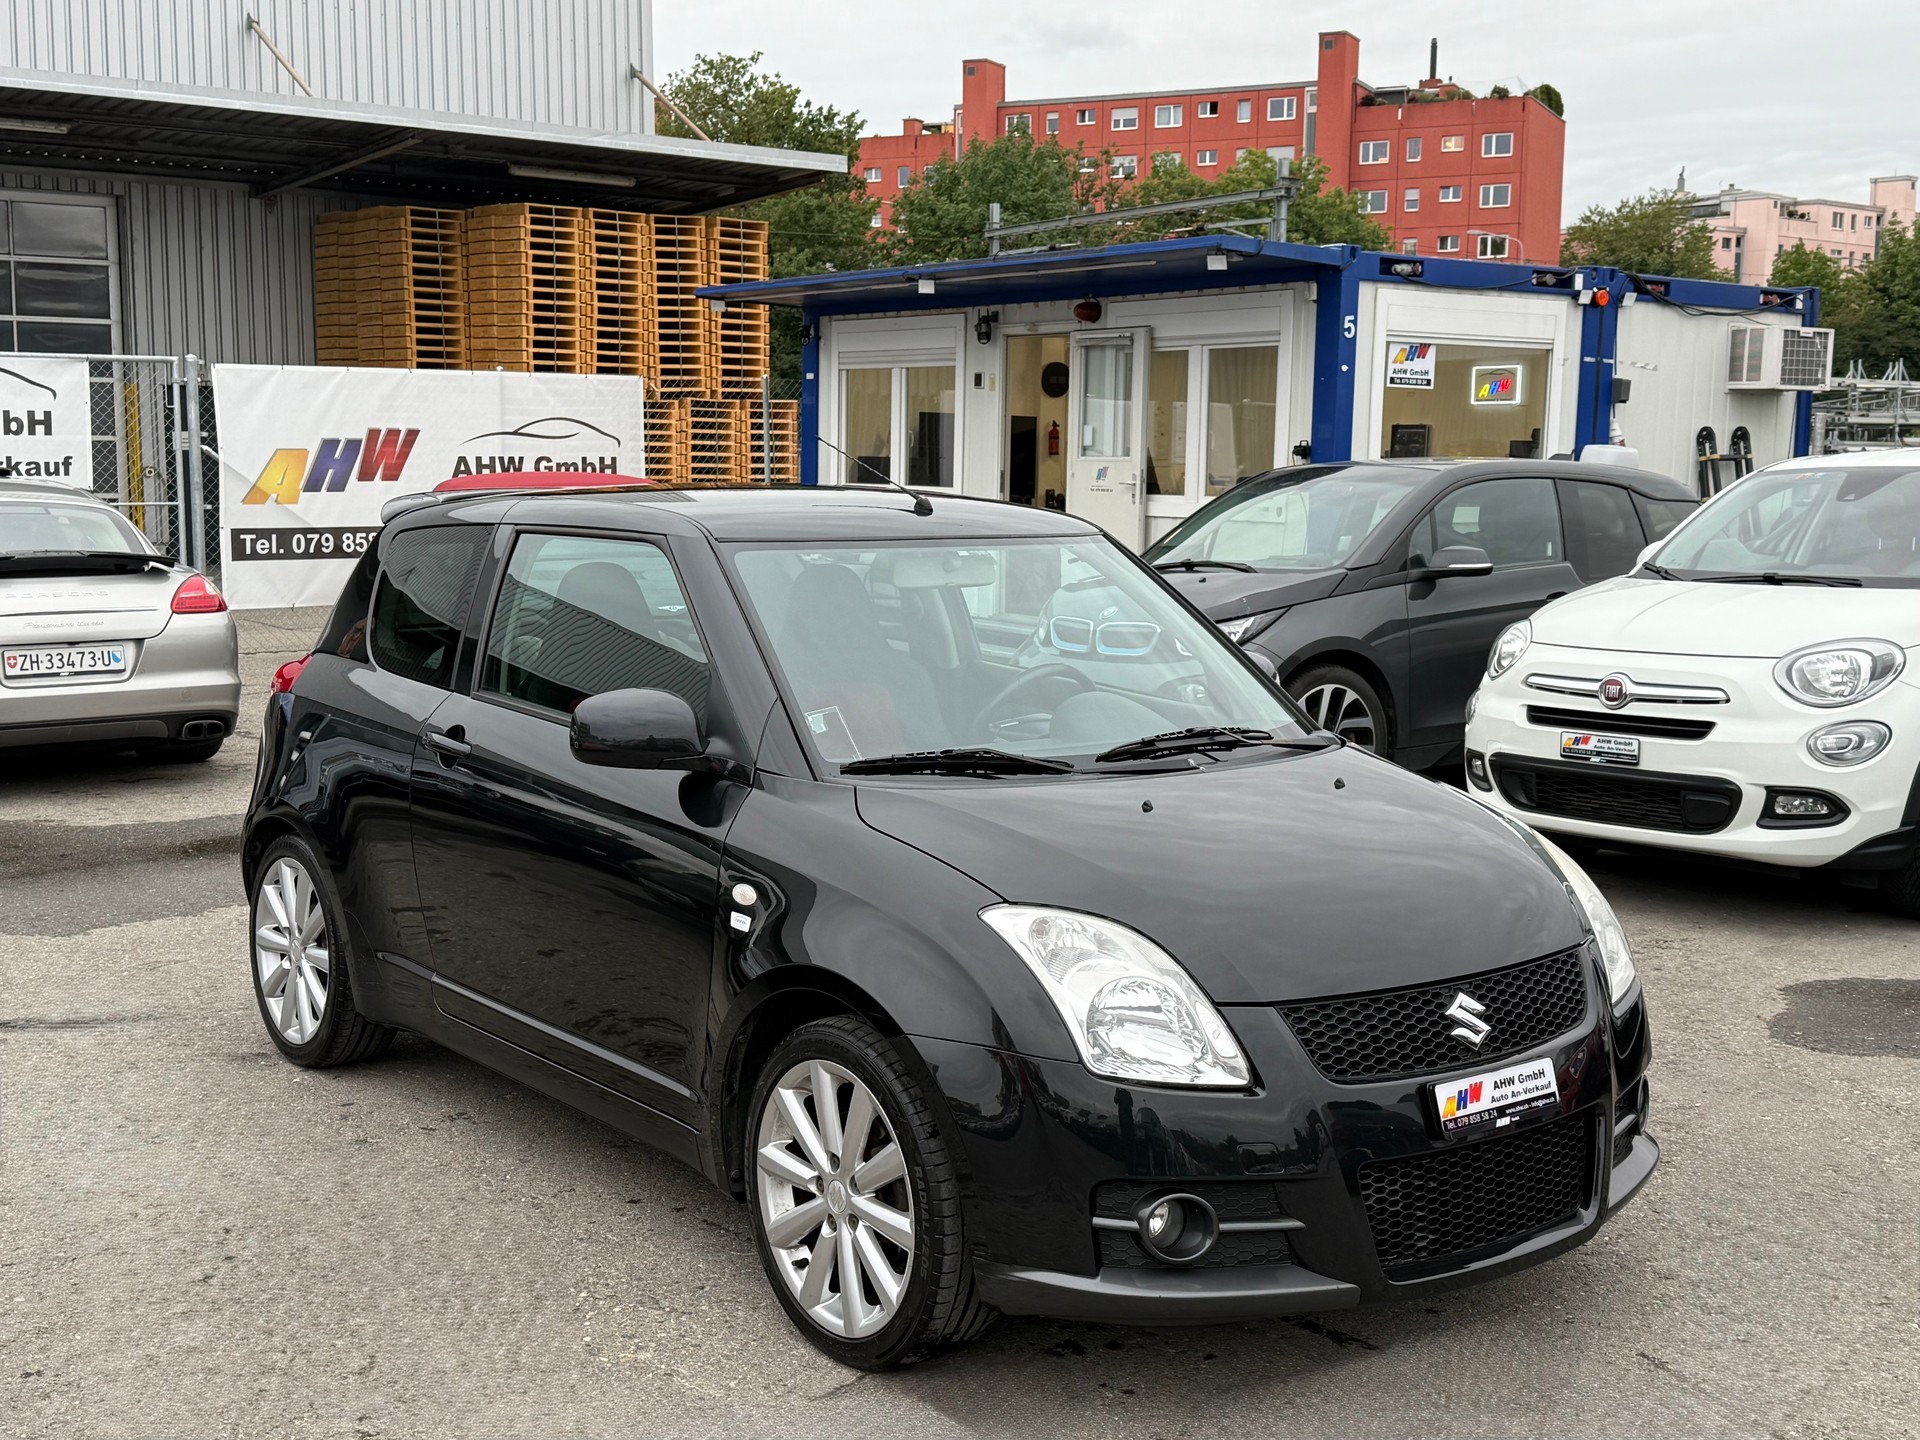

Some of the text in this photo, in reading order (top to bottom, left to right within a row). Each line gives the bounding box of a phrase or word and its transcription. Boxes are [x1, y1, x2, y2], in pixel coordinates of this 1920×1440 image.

[1343, 314, 1356, 339] 5
[1392, 343, 1431, 365] AHW
[1392, 368, 1430, 377] AHW GmbH
[1478, 378, 1512, 398] AHW
[0, 455, 74, 477] kauf
[241, 427, 421, 505] AHW
[452, 455, 525, 479] AHW
[240, 534, 285, 555] Tel.
[292, 533, 335, 554] 079
[1605, 685, 1621, 698] FIAT
[1563, 735, 1592, 747] AHW
[1493, 1068, 1545, 1091] AHW GmbH
[1442, 1080, 1483, 1119] AHW
[1491, 1080, 1552, 1104] Auto An-Verkauf
[1445, 1119, 1457, 1130] Tel.
[1457, 1116, 1469, 1127] 079
[1469, 1113, 1481, 1124] 858
[1481, 1111, 1490, 1121] 58
[1489, 1109, 1498, 1119] 24
